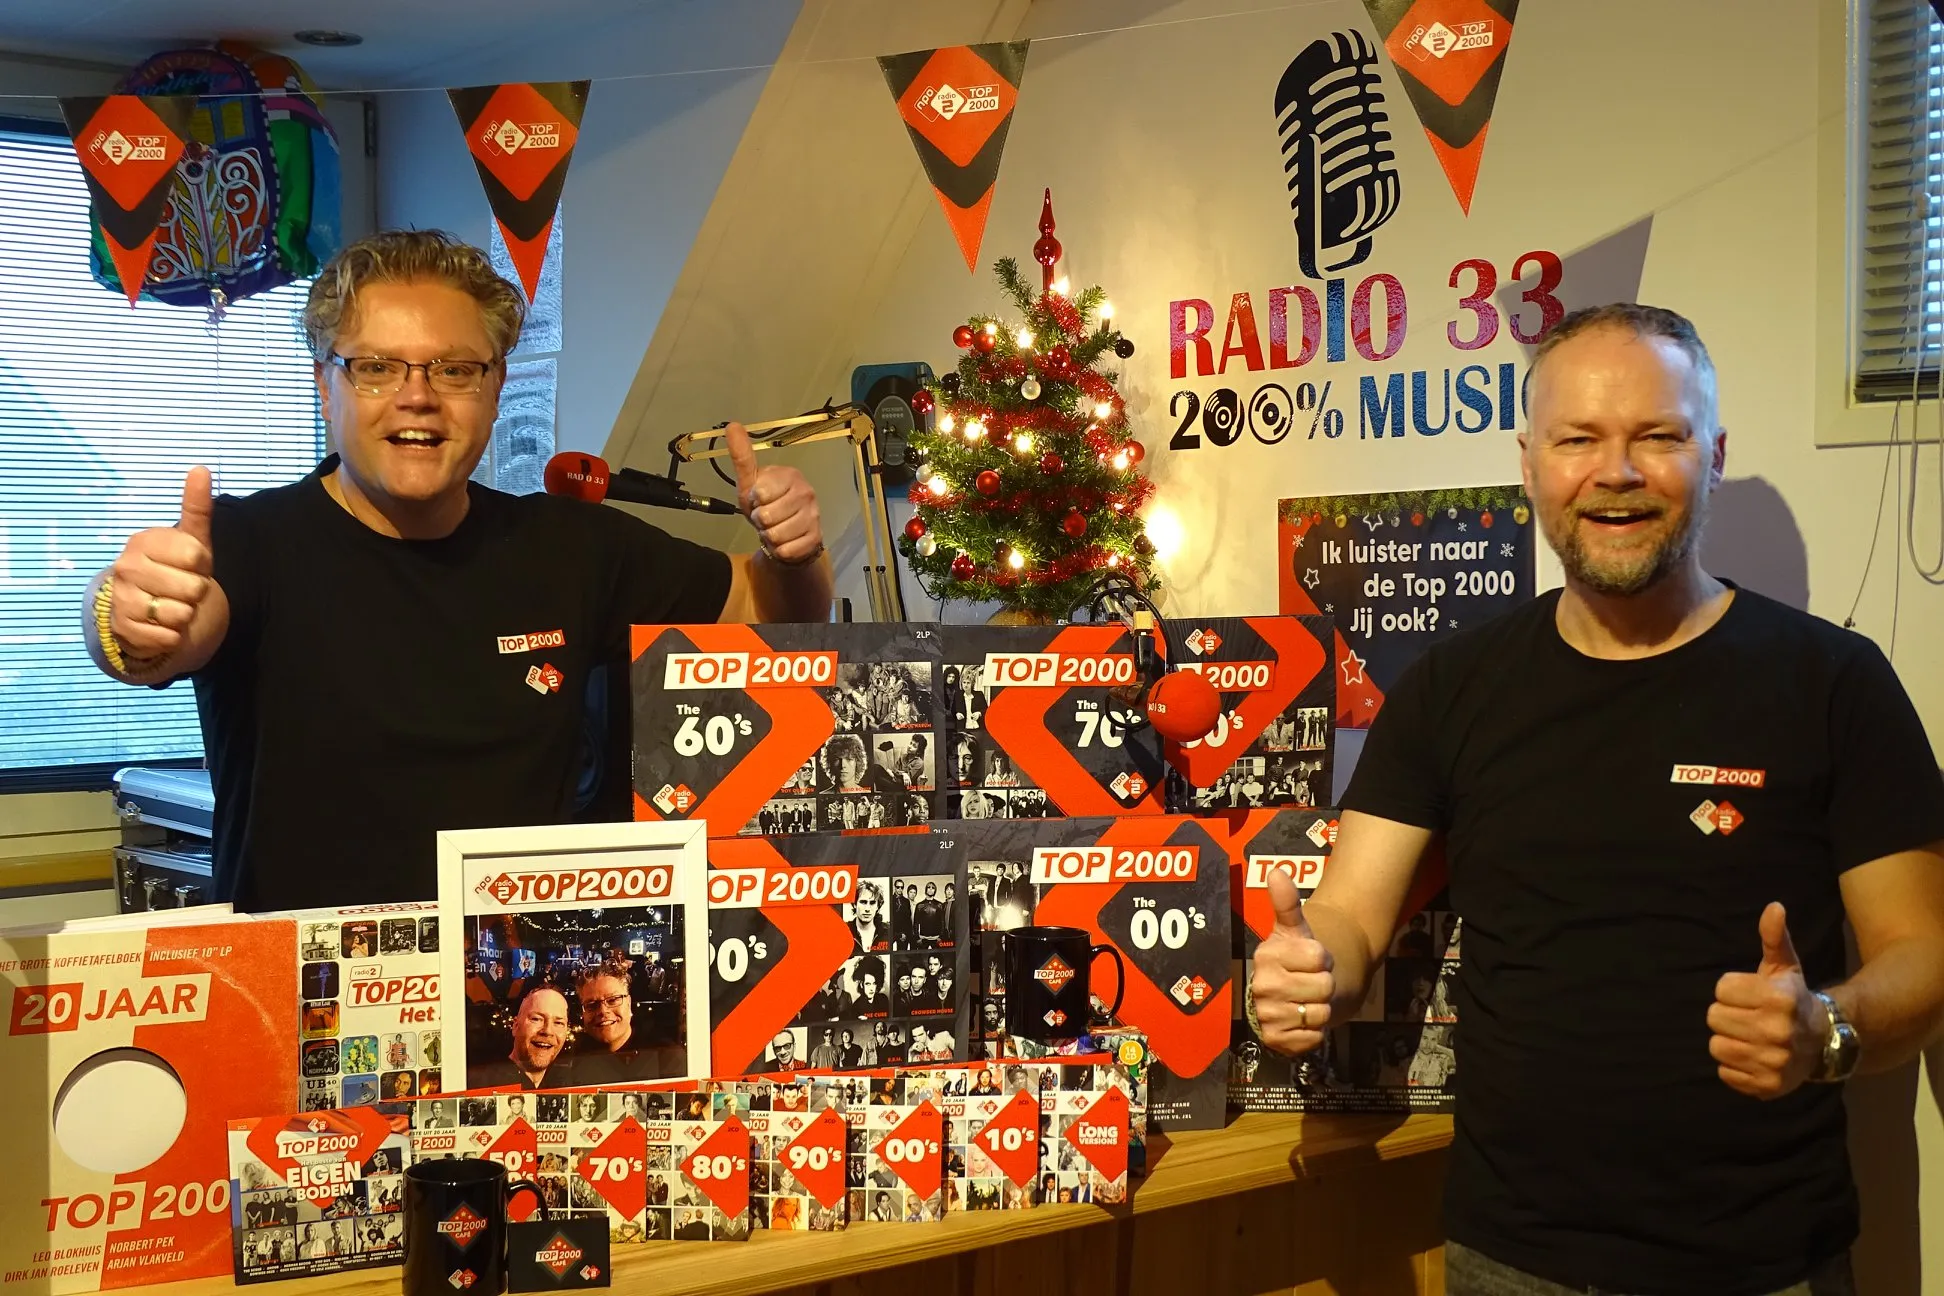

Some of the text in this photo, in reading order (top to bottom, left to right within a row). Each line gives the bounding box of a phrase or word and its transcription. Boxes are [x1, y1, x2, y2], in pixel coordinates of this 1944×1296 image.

[1405, 27, 1448, 51] npo radio 2
[1462, 23, 1487, 35] TOP
[1461, 35, 1490, 48] 2000
[916, 88, 934, 110] npo
[942, 100, 953, 113] 2
[970, 87, 992, 98] TOP
[969, 99, 996, 110] 2000
[482, 123, 498, 143] npo
[505, 136, 515, 148] 2
[530, 125, 554, 135] TOP
[90, 133, 106, 152] npo
[112, 146, 122, 158] 2
[138, 137, 160, 147] TOP
[529, 137, 556, 146] 2000
[136, 149, 162, 158] 2000
[1169, 250, 1565, 380] RADIO 33
[1169, 362, 1528, 451] 200% MUSI
[593, 476, 605, 485] 33
[1322, 538, 1489, 565] Ik luister naar
[1363, 570, 1516, 603] de Top 2000
[1350, 607, 1440, 639] Jij ook?
[500, 632, 562, 651] TOP 2000
[1187, 631, 1200, 646] npo
[1205, 640, 1215, 650] 2
[527, 668, 559, 687] npo radio 2
[674, 656, 832, 684] TOP 2000
[991, 658, 1133, 682] TOP 2000
[1206, 664, 1269, 688] 2000
[676, 704, 700, 715] The
[1077, 700, 1098, 710] The
[673, 713, 753, 757] 60's
[1075, 709, 1142, 748] 70's
[1110, 774, 1126, 792] npo
[1131, 784, 1141, 794] 2
[1677, 768, 1761, 785] TOP 2000
[655, 786, 671, 803] npo
[677, 797, 688, 808] 2
[1693, 803, 1712, 821] npo
[1719, 816, 1733, 829] 2
[1308, 821, 1324, 837] npo
[940, 841, 954, 849] 2LP
[1041, 850, 1193, 878] TOP 2000
[1256, 860, 1317, 883] TOP
[474, 875, 491, 894] npo
[498, 887, 509, 899] 2
[517, 873, 577, 901] TOP
[578, 868, 668, 898] 2000
[768, 870, 852, 901] 2000
[1133, 897, 1156, 907] The
[1130, 906, 1206, 949] 00's
[0, 960, 17, 972] HET
[20, 958, 51, 970] GROTE
[54, 952, 142, 968] KOFFIETAFELBOEK
[149, 948, 199, 962] INCLUSIEF
[220, 946, 232, 957] LP
[370, 968, 377, 976] 2
[1036, 970, 1073, 978] TOP 2000
[352, 976, 440, 1004] TOP 20
[1172, 977, 1206, 1000] npo radio 2
[20, 983, 199, 1026] 20 JAAR
[400, 1006, 435, 1024] Het
[422, 1138, 453, 1148] 2000
[536, 1131, 565, 1142] 2000
[984, 1127, 1034, 1151] 10's
[1078, 1126, 1118, 1138] LONG
[1079, 1137, 1117, 1145] VERSIONS
[283, 1136, 358, 1155] TOP 2000
[885, 1138, 938, 1163] 00's
[489, 1150, 534, 1171] 50's
[589, 1157, 643, 1181] 70's
[692, 1155, 746, 1180] 80's
[789, 1146, 842, 1171] 90's
[286, 1161, 362, 1188] EIGEN
[296, 1183, 354, 1201] BODEM
[41, 1179, 231, 1232] TOP 200
[441, 1219, 486, 1231] TOP 2000
[33, 1236, 175, 1264] LEO BLOKHUIS NORBERT PEK
[540, 1250, 581, 1260] TOP 2000
[4, 1251, 185, 1284] DIRK JAN ROELEVEN ARJAN VLAKVELD
[464, 1276, 471, 1284] 2
